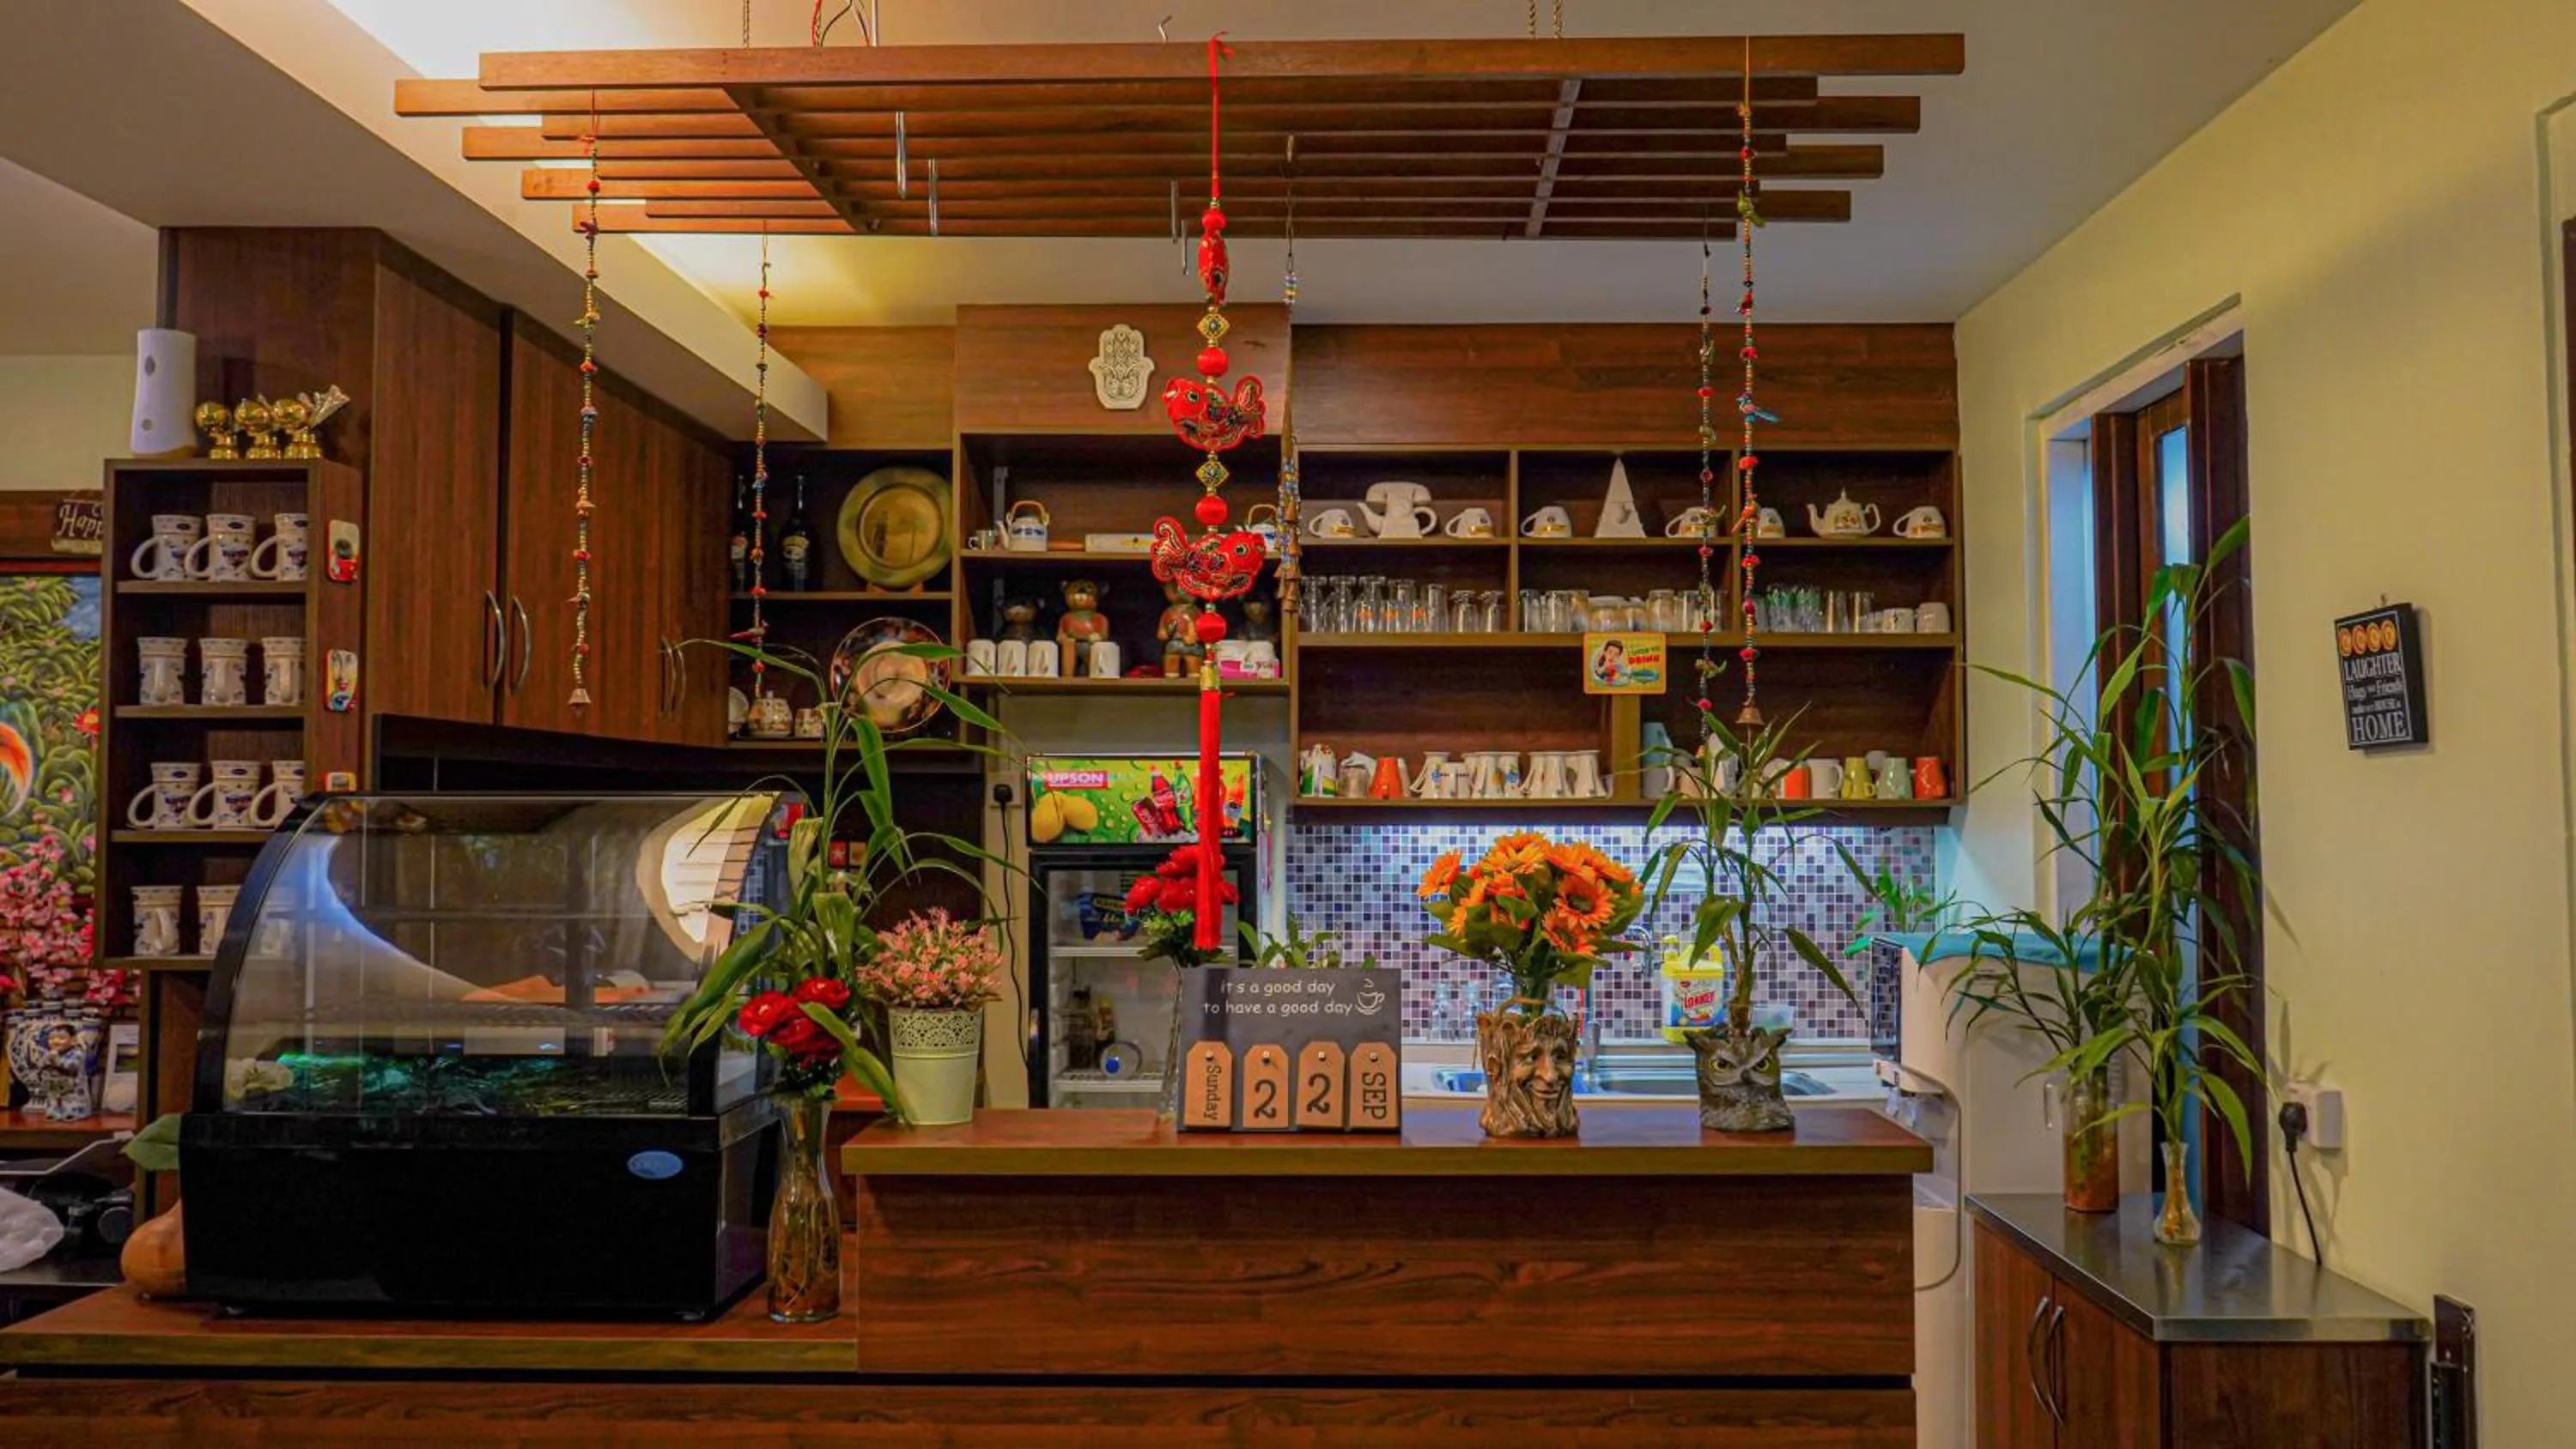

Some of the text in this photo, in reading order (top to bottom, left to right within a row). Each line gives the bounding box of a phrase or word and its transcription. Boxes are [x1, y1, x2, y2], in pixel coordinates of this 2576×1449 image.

[2344, 653, 2403, 681] LAUGHTER
[2351, 710, 2406, 743] HOME
[1249, 983, 1260, 994] a
[1264, 979, 1302, 996] good
[1308, 979, 1335, 996] day
[1204, 1000, 1353, 1016] to have a good day
[1204, 1064, 1387, 1121] Sunday 2 2 SEP
